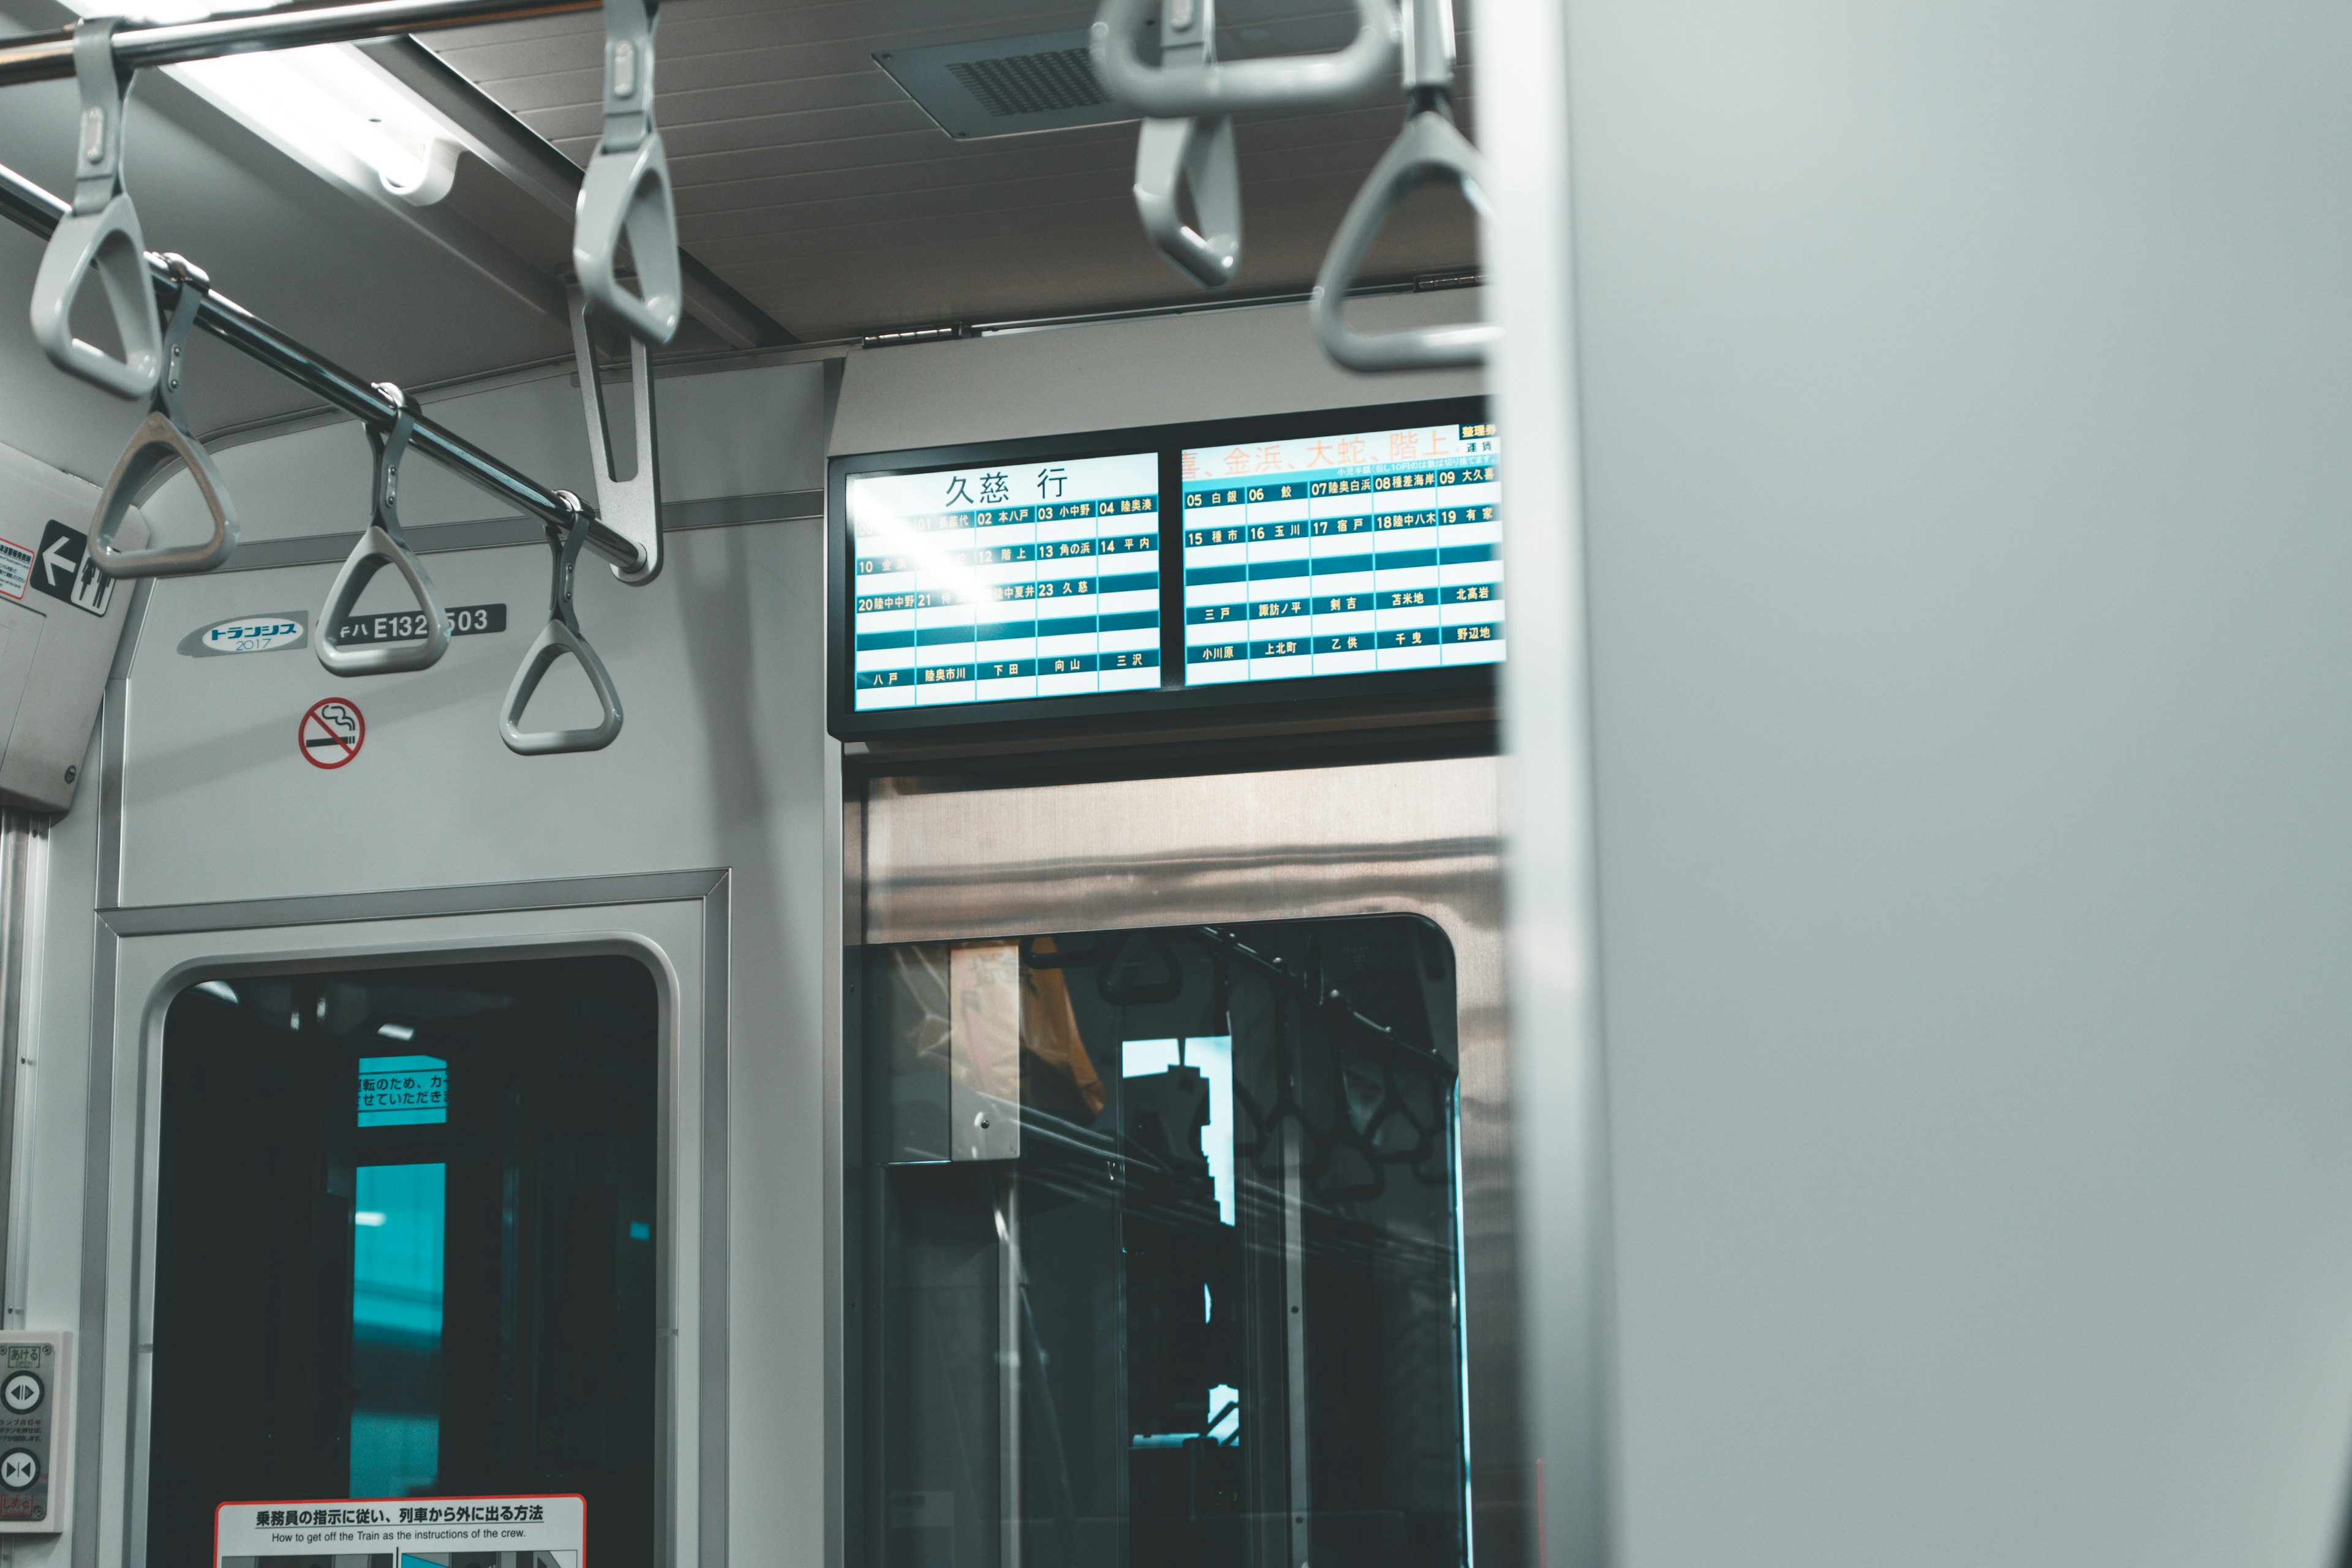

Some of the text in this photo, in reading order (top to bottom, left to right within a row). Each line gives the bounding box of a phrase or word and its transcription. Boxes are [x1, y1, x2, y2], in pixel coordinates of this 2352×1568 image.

[946, 468, 1068, 507] 久慈 行
[1186, 467, 1494, 507] 05 白銀 06 鮫 07 陸奥白浜 08 種差海岸 09 大久喜
[919, 518, 931, 530] 01
[939, 514, 968, 528] 長苗代
[977, 513, 992, 526] 02
[998, 509, 1028, 523] 本八戸
[1038, 507, 1053, 520] 03
[1059, 503, 1090, 518] 小中野
[1099, 502, 1114, 515] 04
[1121, 498, 1152, 513] 陸奥湊
[1188, 507, 1493, 545] 15 種市 16 玉川 17 宿戸 18 陸中八木 19 有家
[859, 560, 873, 573] 10
[882, 558, 907, 571] 金浜
[979, 551, 992, 563] 12
[1001, 548, 1026, 561] 階上
[1039, 545, 1053, 557] 13
[1060, 541, 1090, 556] 角の浜
[1101, 540, 1115, 552] 14
[1124, 537, 1150, 550] 平内
[858, 599, 873, 611] 20
[874, 595, 914, 609] 陸中中野
[918, 594, 930, 606] 21
[1038, 584, 1054, 596] 23
[1063, 581, 1088, 594] 久慈
[1205, 586, 1489, 620] 三戸 諏訪ノ平 剣吉 苫米地 北高岩
[211, 623, 296, 640] トランシス
[235, 638, 272, 652] 2017
[1202, 626, 1491, 660] 小川原 上北町 乙供 千曳 野辺地
[873, 653, 1142, 685] 八戸 陸奥市川 下田 向山 三沢
[357, 1090, 451, 1107] せていただきま
[10, 1348, 38, 1360] あける
[256, 1505, 543, 1526] 乗務員の指示に従い、列車から外に出る方法
[272, 1533, 292, 1542] How
[295, 1532, 304, 1542] to
[307, 1532, 322, 1544] get
[324, 1532, 336, 1541] off
[339, 1531, 353, 1540] the
[357, 1531, 380, 1540] Train
[397, 1530, 412, 1539] the
[415, 1529, 469, 1539] instructions
[471, 1528, 481, 1538] of
[484, 1528, 498, 1538] the
[501, 1529, 526, 1538] crew.
